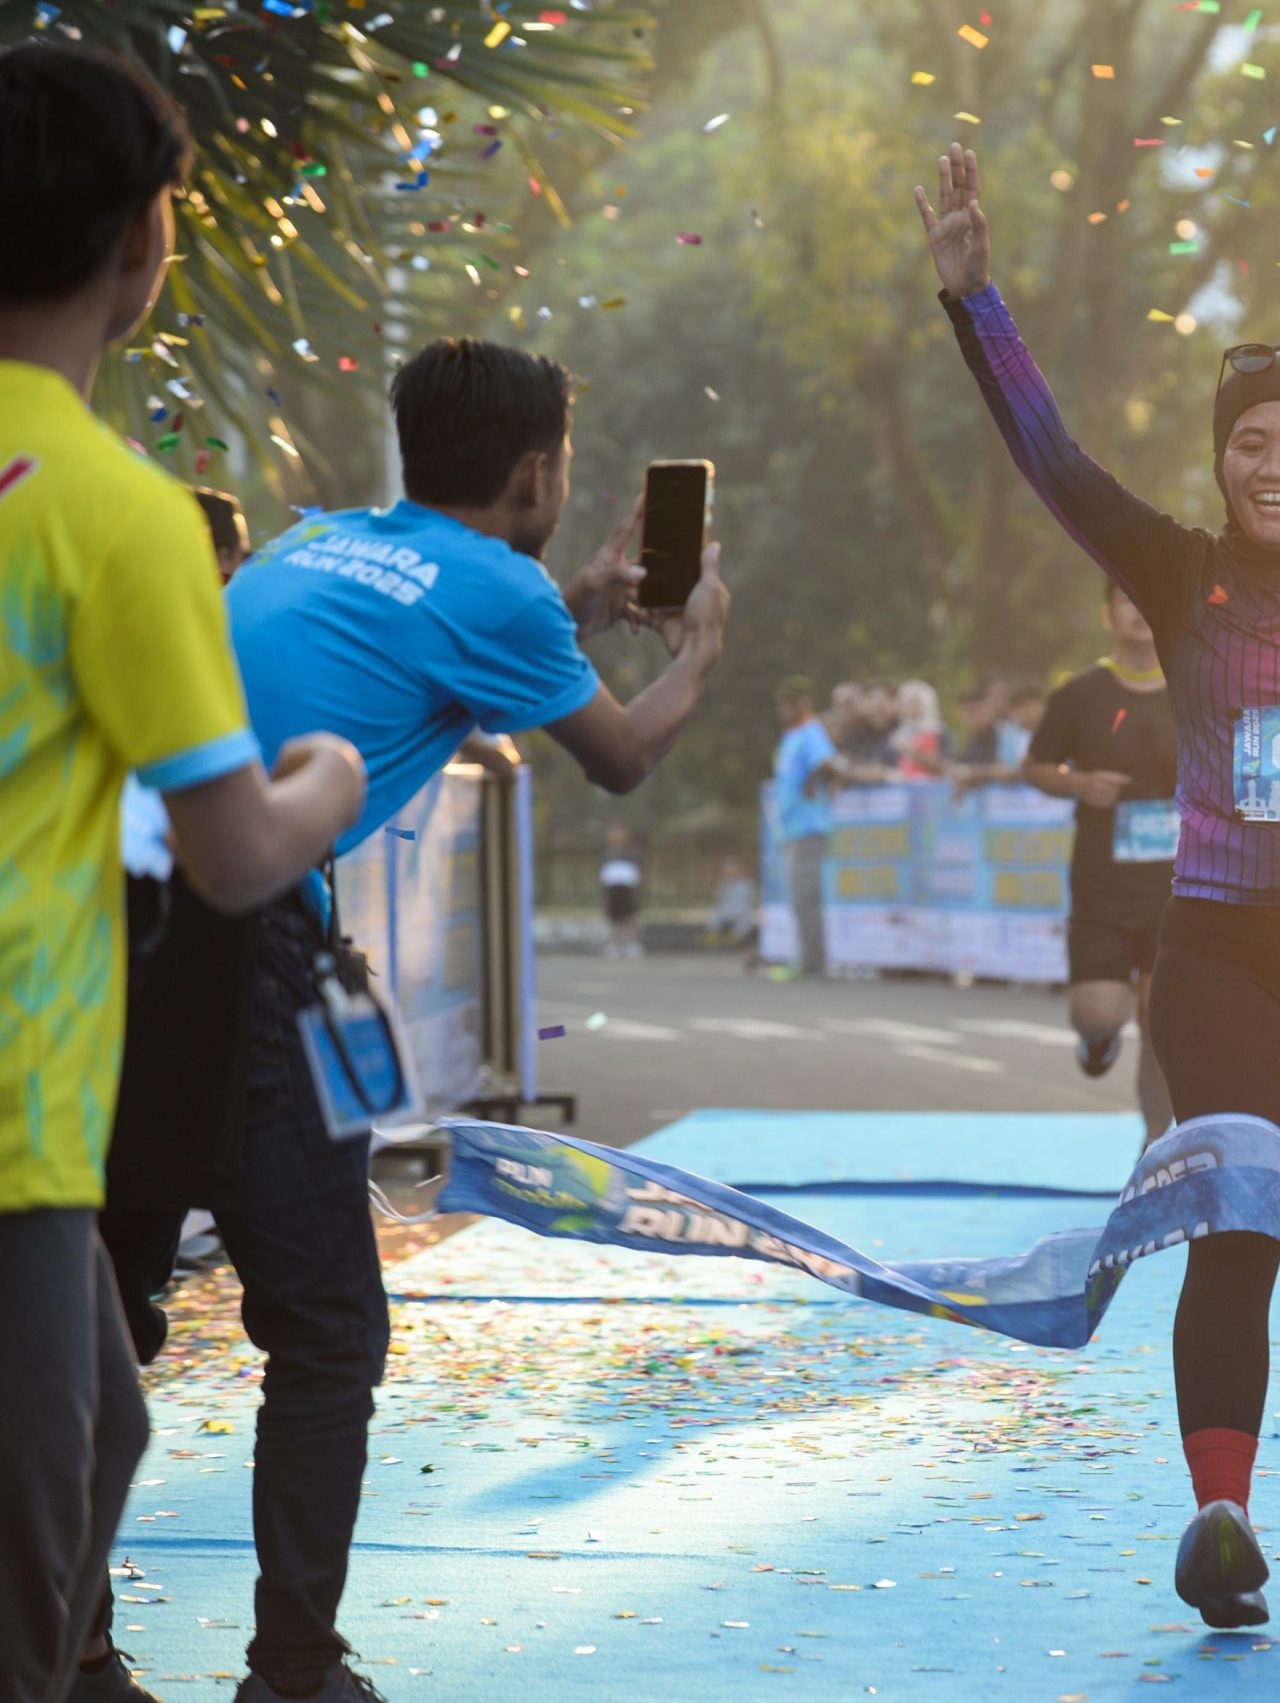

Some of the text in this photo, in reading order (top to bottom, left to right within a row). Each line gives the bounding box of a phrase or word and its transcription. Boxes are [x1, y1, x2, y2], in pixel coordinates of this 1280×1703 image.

[283, 550, 426, 607] RUN 2025
[308, 535, 440, 590] JAWARA
[1243, 709, 1251, 756] JAWARA
[1251, 739, 1260, 758] RUN
